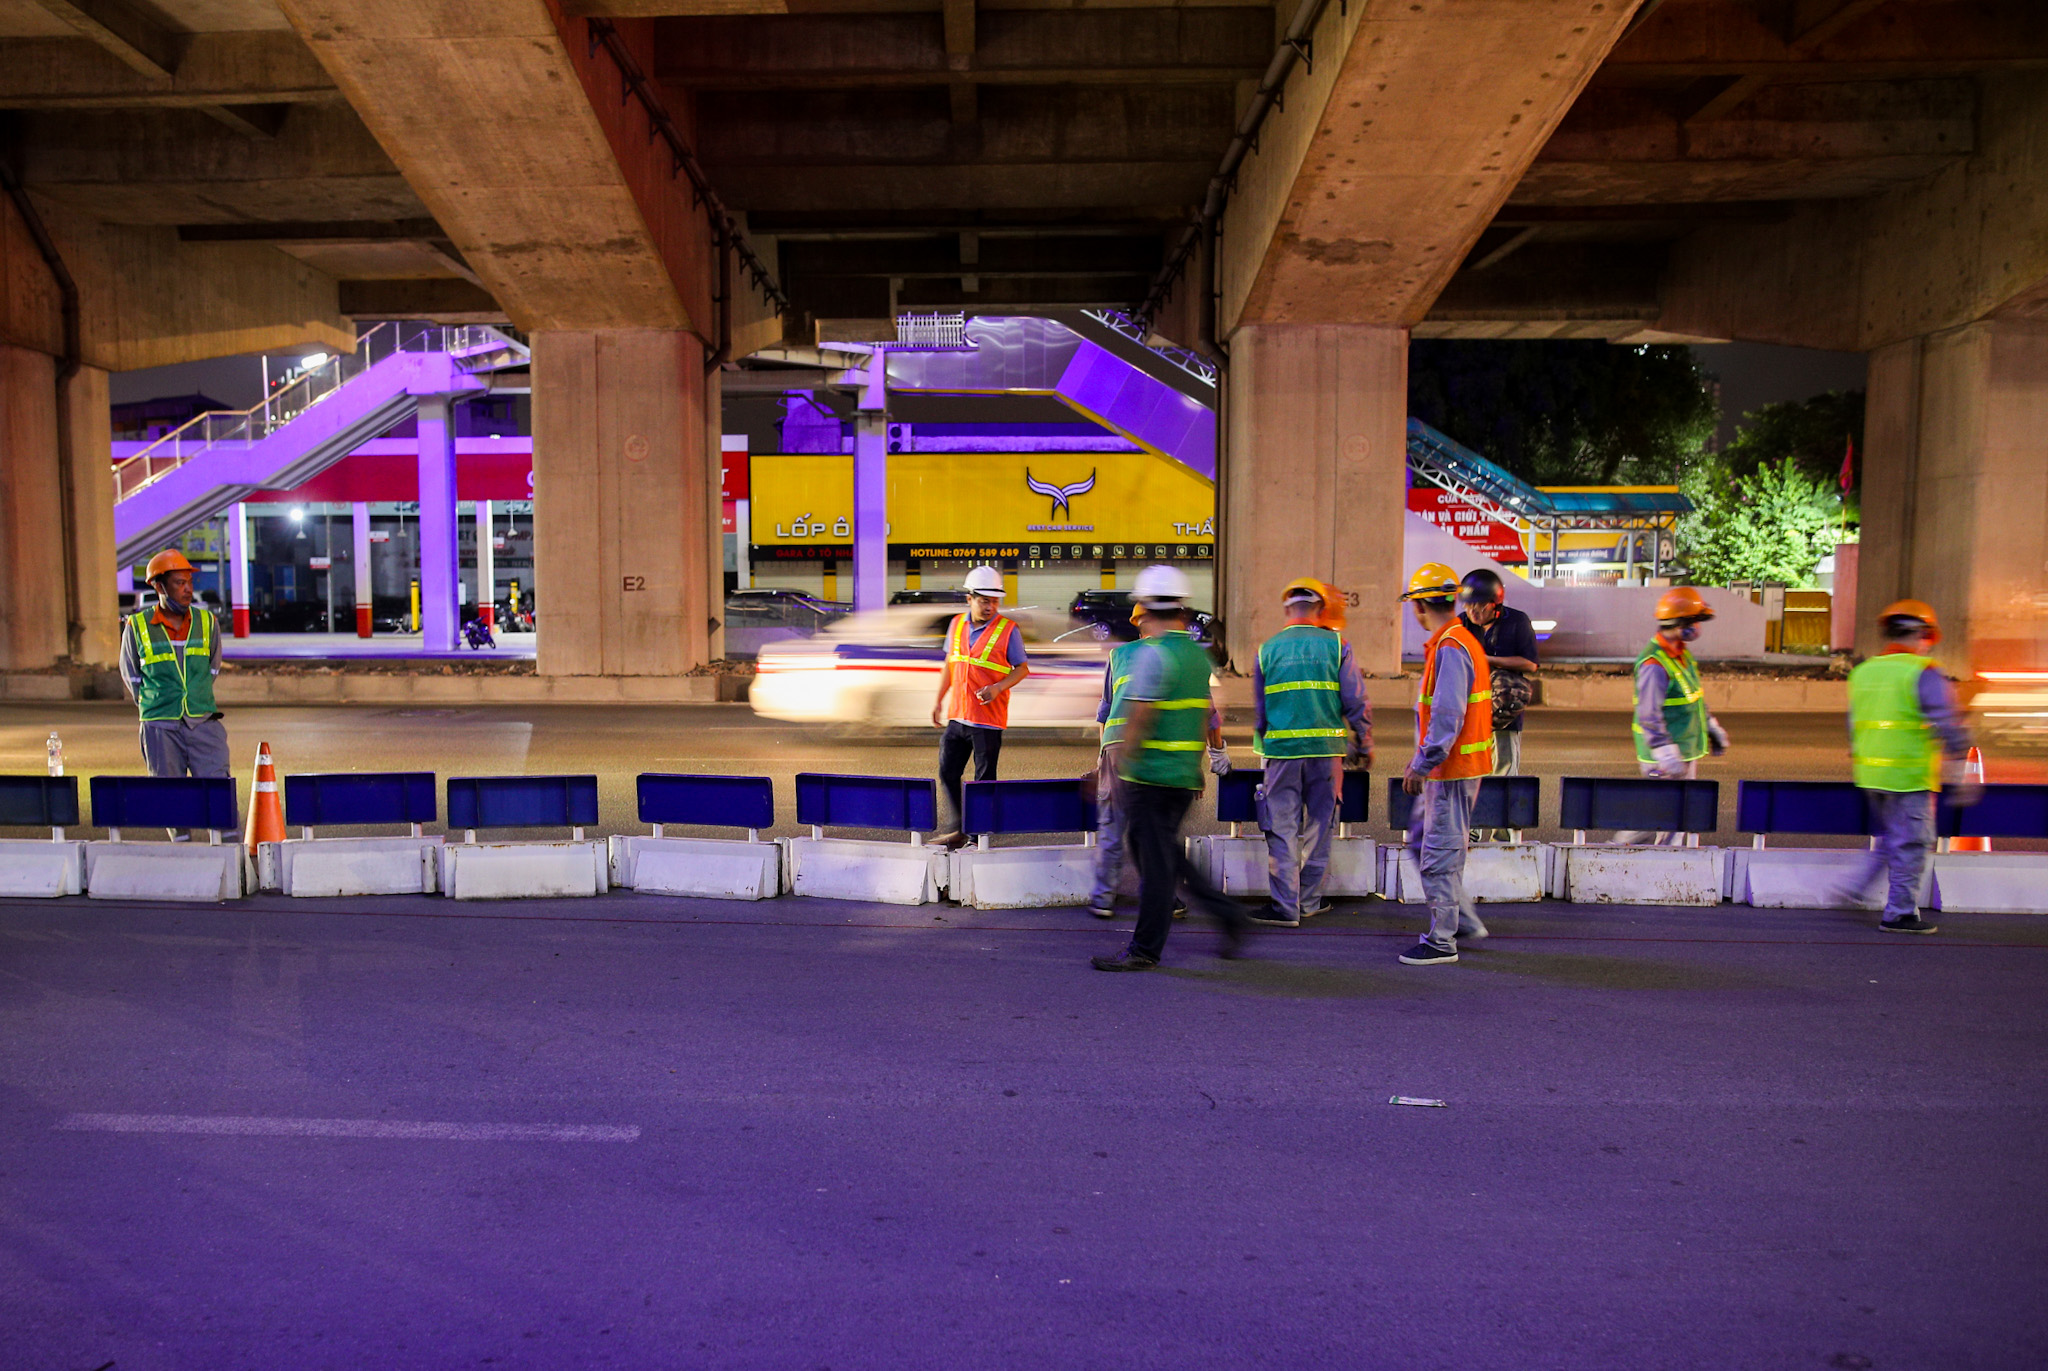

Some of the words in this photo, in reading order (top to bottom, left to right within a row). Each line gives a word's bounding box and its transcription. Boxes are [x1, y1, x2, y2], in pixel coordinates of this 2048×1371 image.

[1438, 509, 1452, 522] VÀ
[1454, 508, 1478, 522] GIỚI
[776, 512, 826, 537] LỐP
[833, 515, 850, 537] Ô
[1027, 524, 1046, 532] BEST
[1047, 524, 1063, 532] CAR
[1063, 524, 1095, 532] SERVICE
[1173, 516, 1215, 536] THẨ
[776, 549, 804, 558] GARA
[807, 547, 816, 558] Ô
[819, 547, 832, 558] TÔ
[910, 548, 952, 557] HOTLINE:
[953, 548, 976, 557] 0769
[979, 548, 998, 557] 589
[1000, 548, 1020, 557] 689
[623, 576, 646, 591] E2
